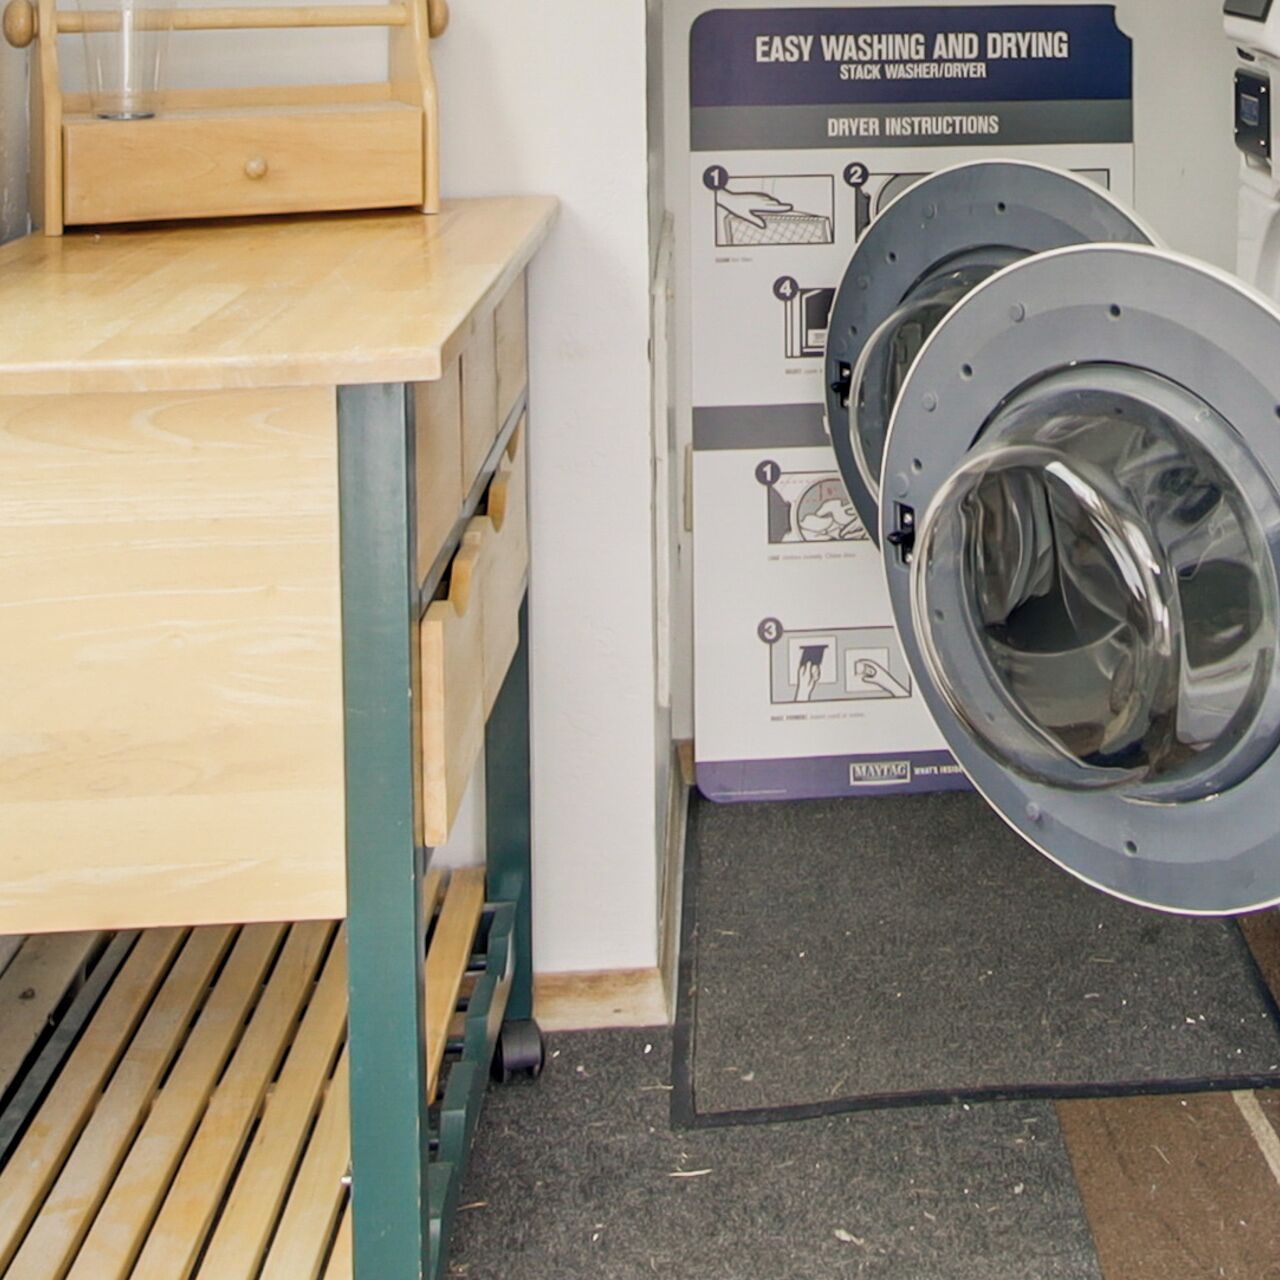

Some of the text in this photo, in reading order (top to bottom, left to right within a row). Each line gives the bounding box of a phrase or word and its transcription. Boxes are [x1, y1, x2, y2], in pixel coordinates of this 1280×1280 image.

[756, 31, 1068, 62] EASY WASHING AND DRYING
[840, 62, 987, 80] STACK WASHER/DRYER
[827, 115, 999, 136] DRYER INSTRUCTIONS
[710, 169, 720, 186] 1
[850, 166, 863, 183] 2
[779, 280, 792, 297] 4
[763, 464, 772, 481] 1
[764, 621, 777, 640] 3
[854, 764, 906, 778] MAYTAG
